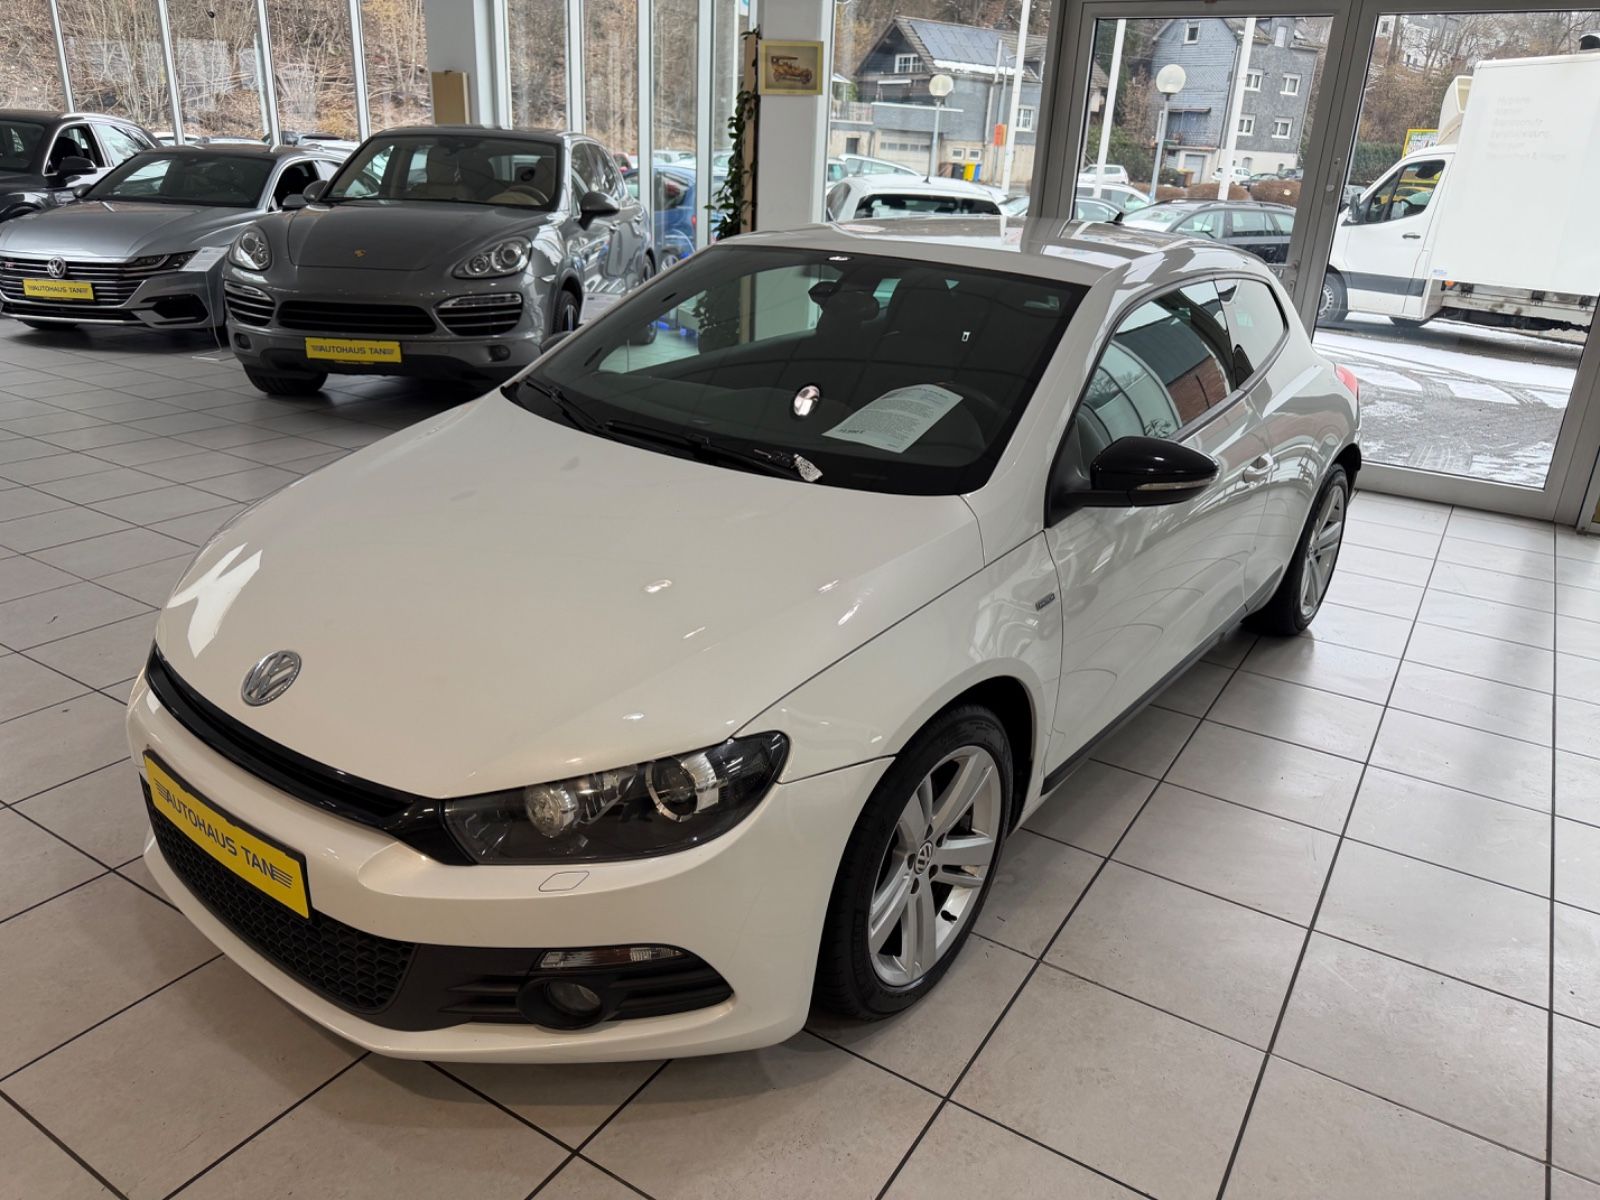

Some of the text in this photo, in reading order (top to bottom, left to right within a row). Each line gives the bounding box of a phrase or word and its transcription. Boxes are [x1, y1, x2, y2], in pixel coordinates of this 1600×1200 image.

[32, 285, 67, 293] AUTOHAUS
[320, 345, 385, 355] AUTOHAUS TAN
[166, 788, 276, 881] AUTOHAUS TAN
